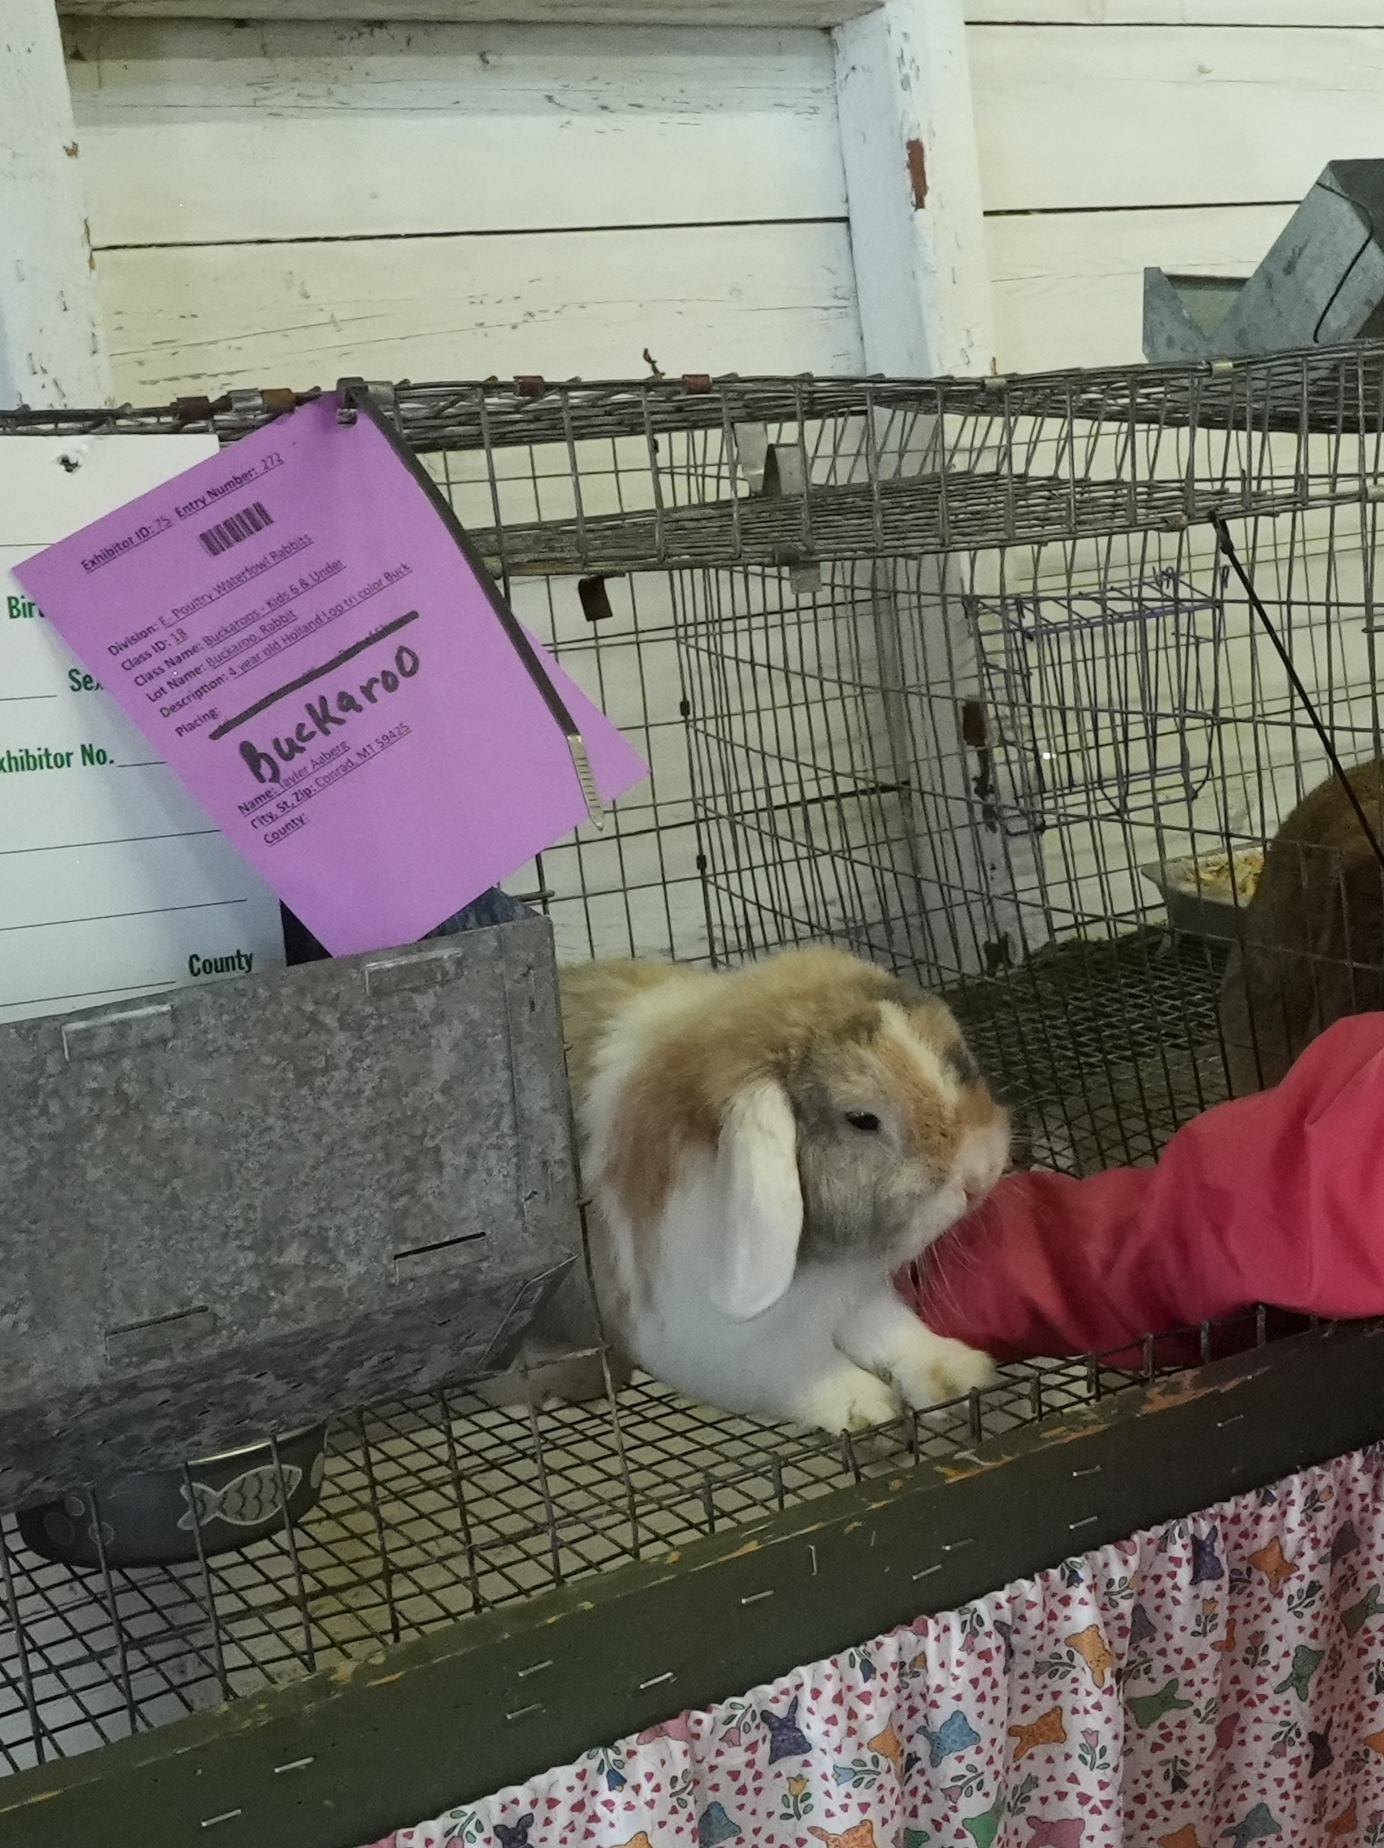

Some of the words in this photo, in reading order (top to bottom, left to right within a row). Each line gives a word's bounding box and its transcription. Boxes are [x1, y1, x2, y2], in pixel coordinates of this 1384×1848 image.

[81, 536, 134, 571] Exhibitor
[135, 525, 155, 541] ID:
[154, 516, 172, 531] 75
[175, 497, 207, 518] Entry
[207, 467, 258, 499] Number:
[262, 452, 284, 471] 272
[108, 623, 159, 656] Division:
[171, 593, 214, 620] Poultry
[212, 557, 270, 595] Waterfowl
[270, 534, 313, 562] Rabbits
[134, 667, 165, 687] Class
[164, 643, 204, 669] Name:
[202, 610, 259, 647] Buckaroos
[267, 591, 290, 610] Kids
[290, 584, 299, 595] 6
[299, 577, 310, 589] &
[309, 558, 344, 582] Under
[121, 651, 152, 671] Class
[151, 639, 171, 653] ID:
[171, 628, 187, 644] 18
[146, 686, 168, 703] Lot
[167, 663, 206, 690] Name:
[259, 609, 297, 635] Rabbit
[159, 674, 229, 718] Description:
[228, 666, 238, 677] 4
[238, 653, 261, 674] year
[263, 641, 282, 656] old
[282, 613, 323, 644] Holland
[321, 602, 345, 623] Lop
[344, 594, 358, 606] tri
[358, 577, 384, 600] color
[384, 562, 411, 583] Buck
[81, 743, 114, 767] No.
[175, 706, 221, 737] Placing:
[237, 786, 277, 814] Name:
[310, 741, 351, 771] Aaberg
[251, 810, 279, 830] City,
[276, 799, 295, 813] St,
[293, 784, 317, 803] Zip:
[315, 758, 359, 789] Conrad,
[356, 743, 375, 761] MT
[375, 722, 411, 748] 59425
[263, 812, 307, 844] County:
[188, 949, 253, 977] County
